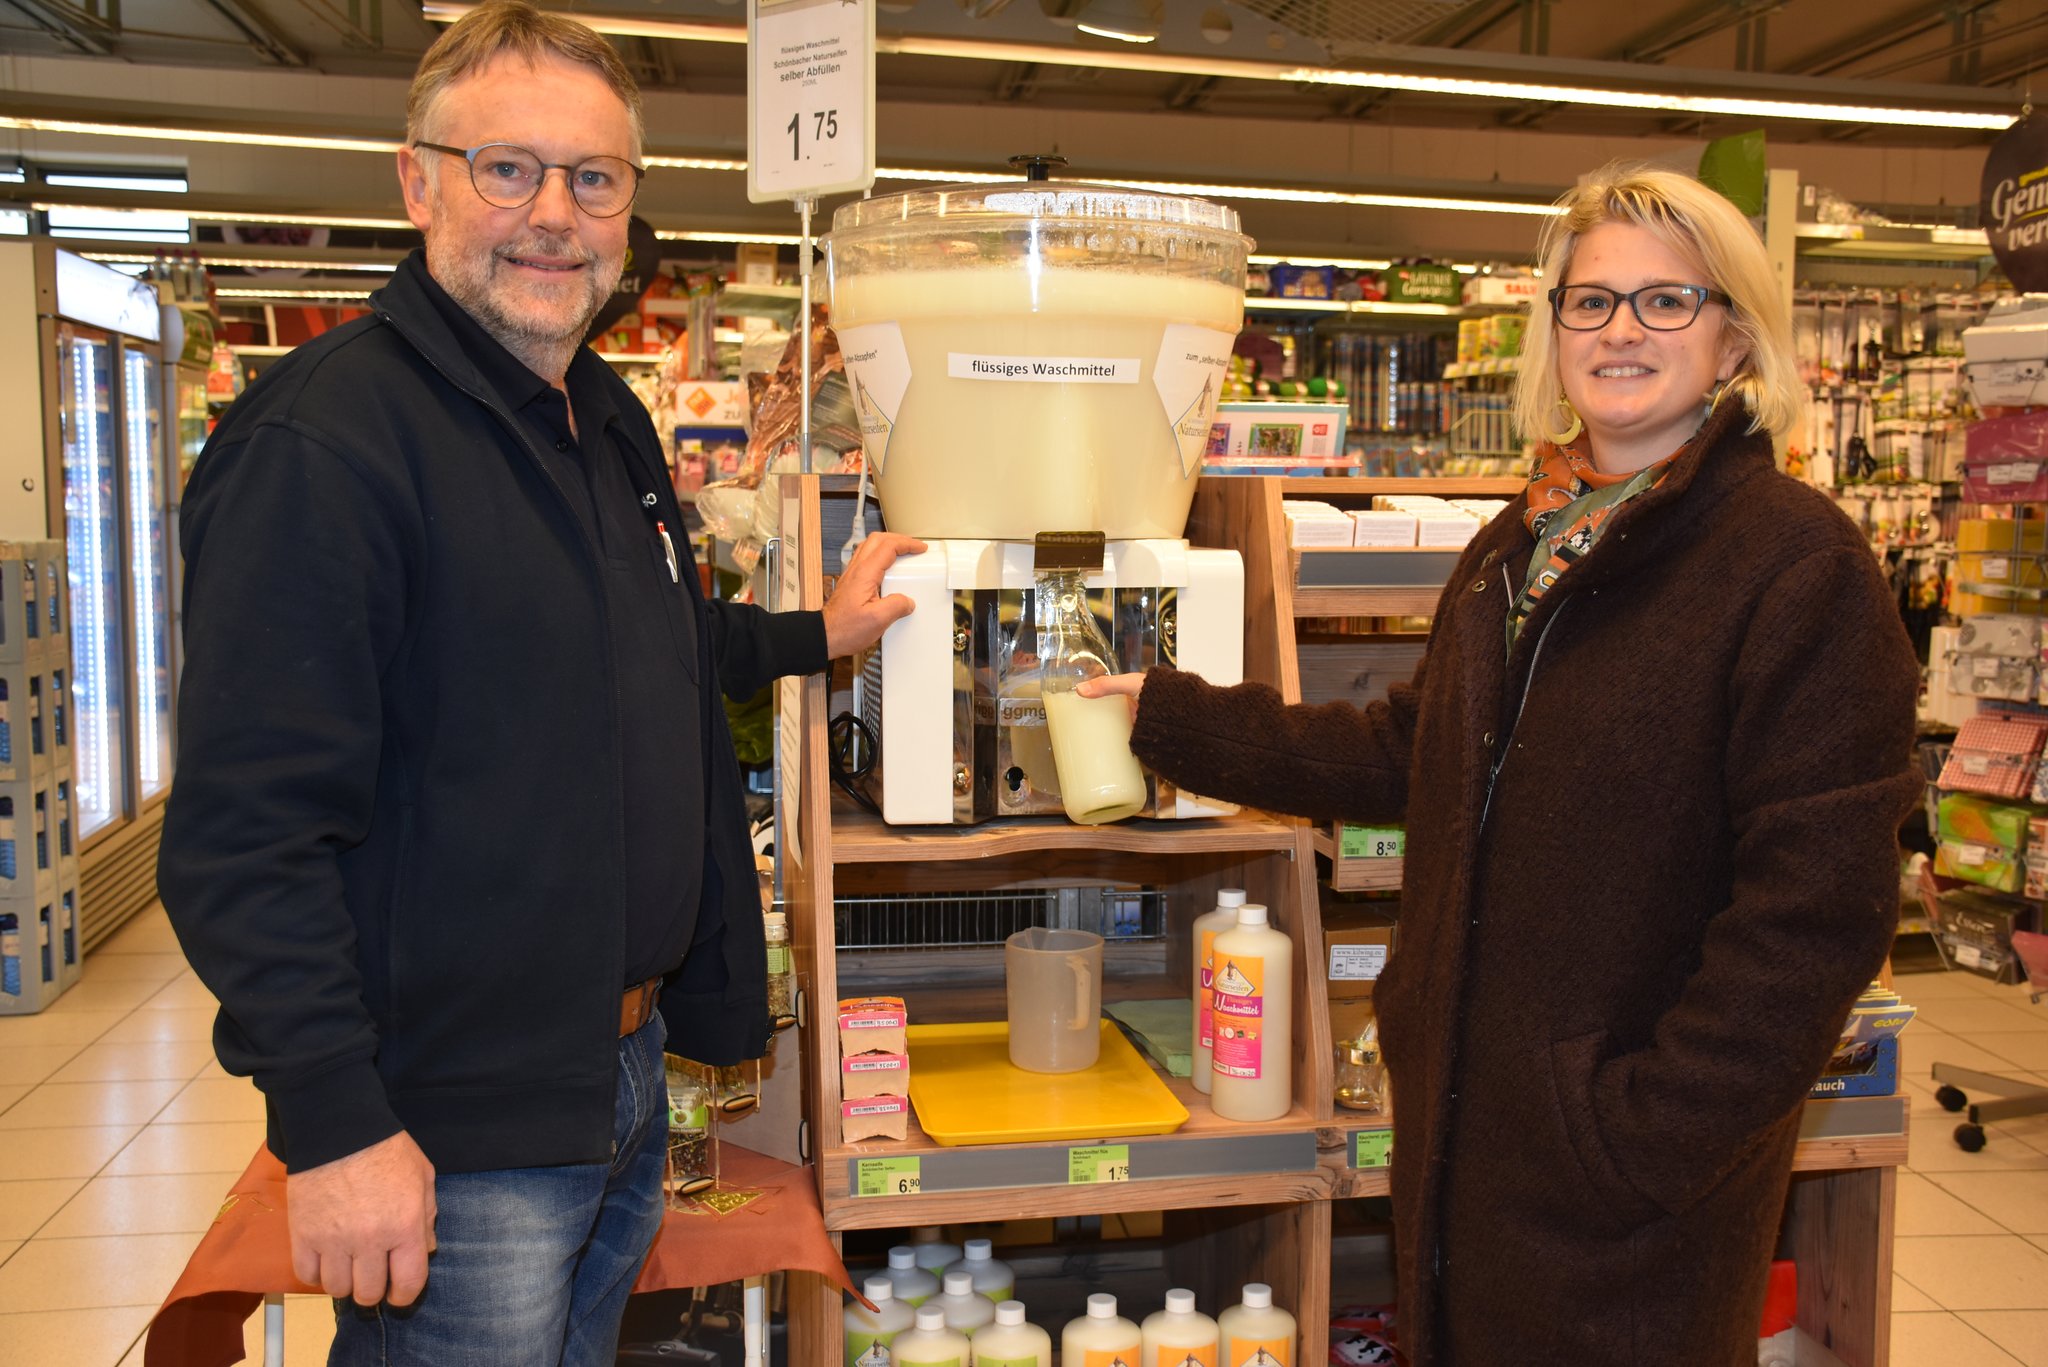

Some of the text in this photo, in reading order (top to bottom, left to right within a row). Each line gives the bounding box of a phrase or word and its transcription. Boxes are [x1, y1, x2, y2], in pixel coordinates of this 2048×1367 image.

[806, 36, 840, 51] Waschmittel
[813, 49, 847, 62] Naturseifen
[780, 63, 841, 82] selber Abfüllen
[972, 360, 1115, 377] flüssiges Waschmittel
